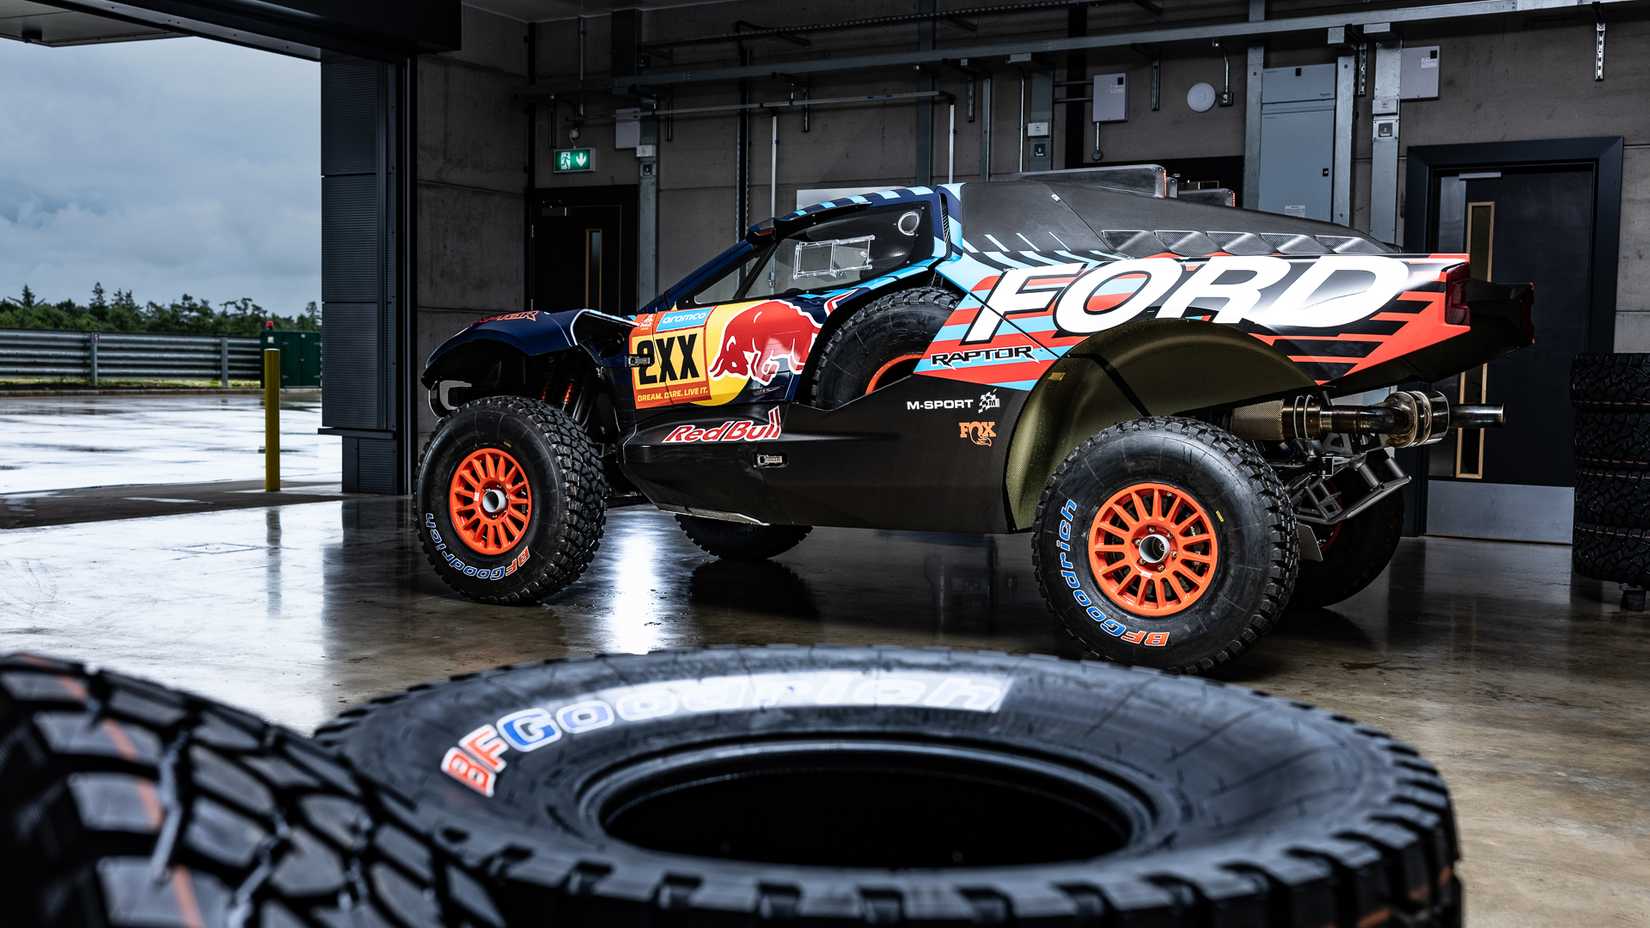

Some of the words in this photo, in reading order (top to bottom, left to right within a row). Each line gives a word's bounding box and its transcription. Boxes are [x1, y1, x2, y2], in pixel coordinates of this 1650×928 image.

[961, 254, 1410, 345] FORD
[662, 312, 706, 324] aramco
[636, 333, 700, 386] 2XX
[930, 345, 1041, 370] RAPTOR
[684, 387, 699, 396] LIVE
[906, 399, 974, 411] M-SPORT
[959, 421, 997, 446] FOX
[425, 512, 531, 581] BFGoodrich
[1055, 498, 1171, 648] BFGoodrich
